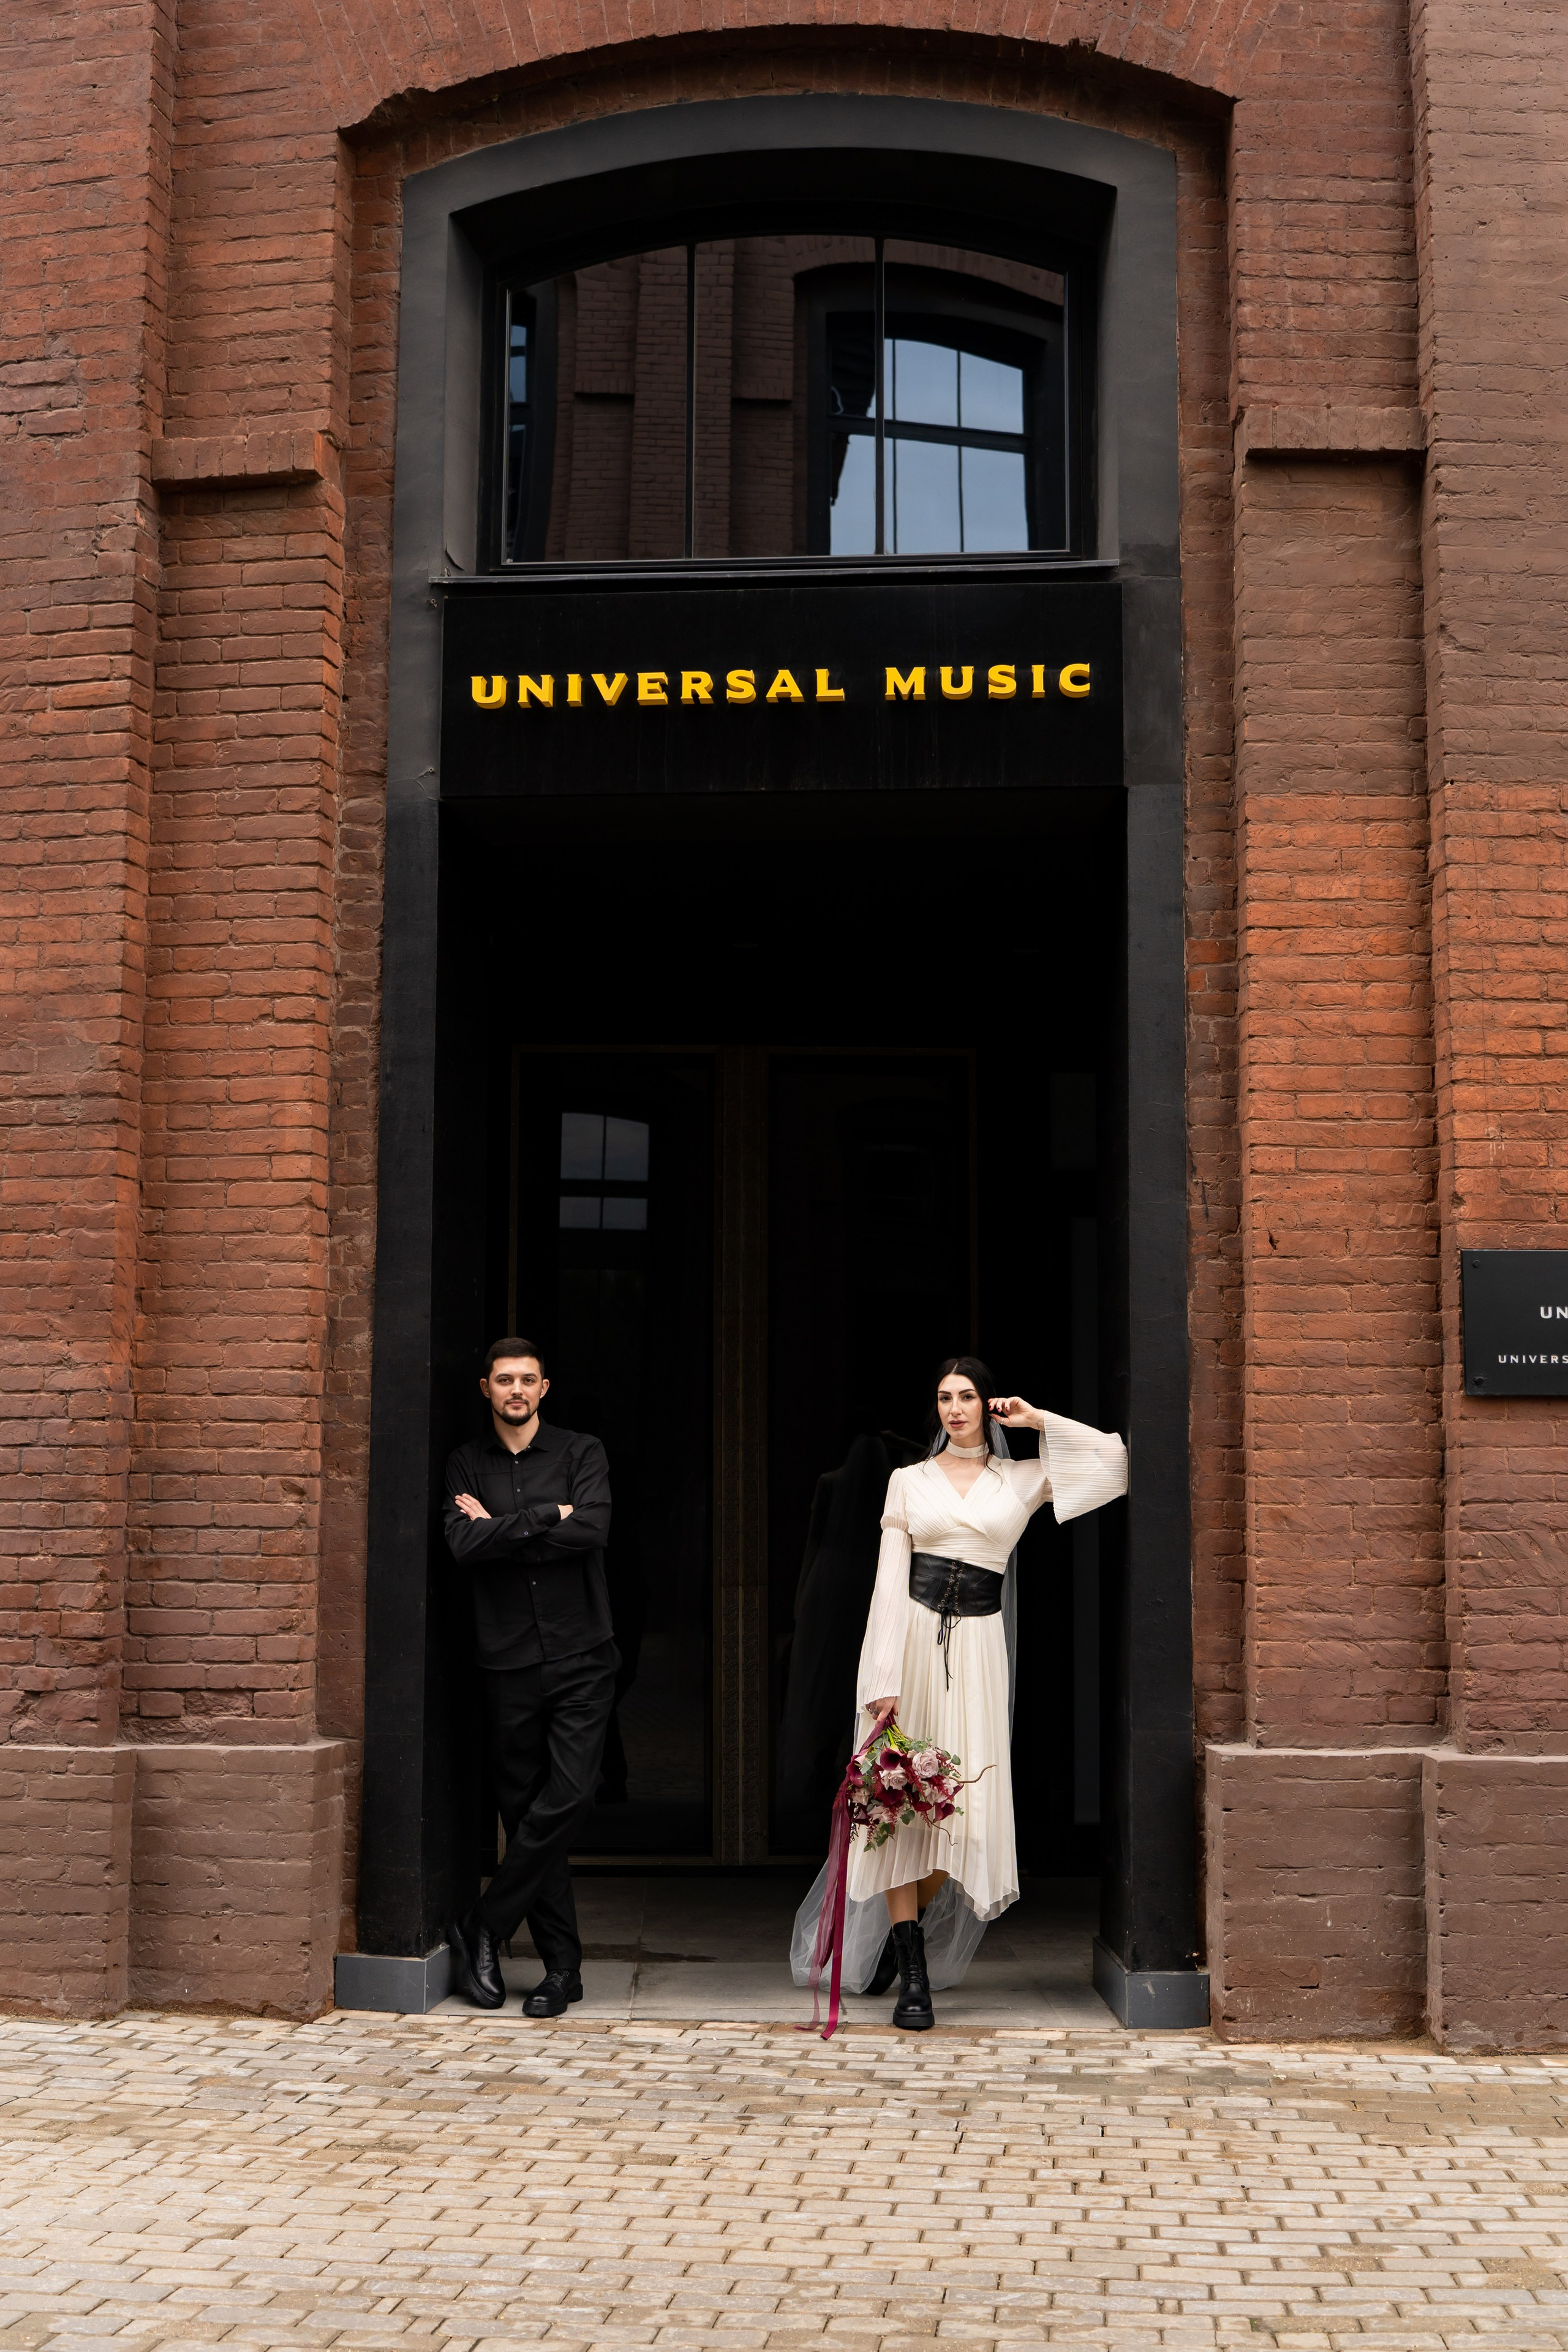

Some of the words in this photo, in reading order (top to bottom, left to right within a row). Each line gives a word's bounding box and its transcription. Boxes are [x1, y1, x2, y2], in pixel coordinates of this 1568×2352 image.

[470, 668, 845, 708] UNIVERSAL
[884, 663, 1091, 701] MUSIC
[1498, 1354, 1568, 1364] UNIVERS
